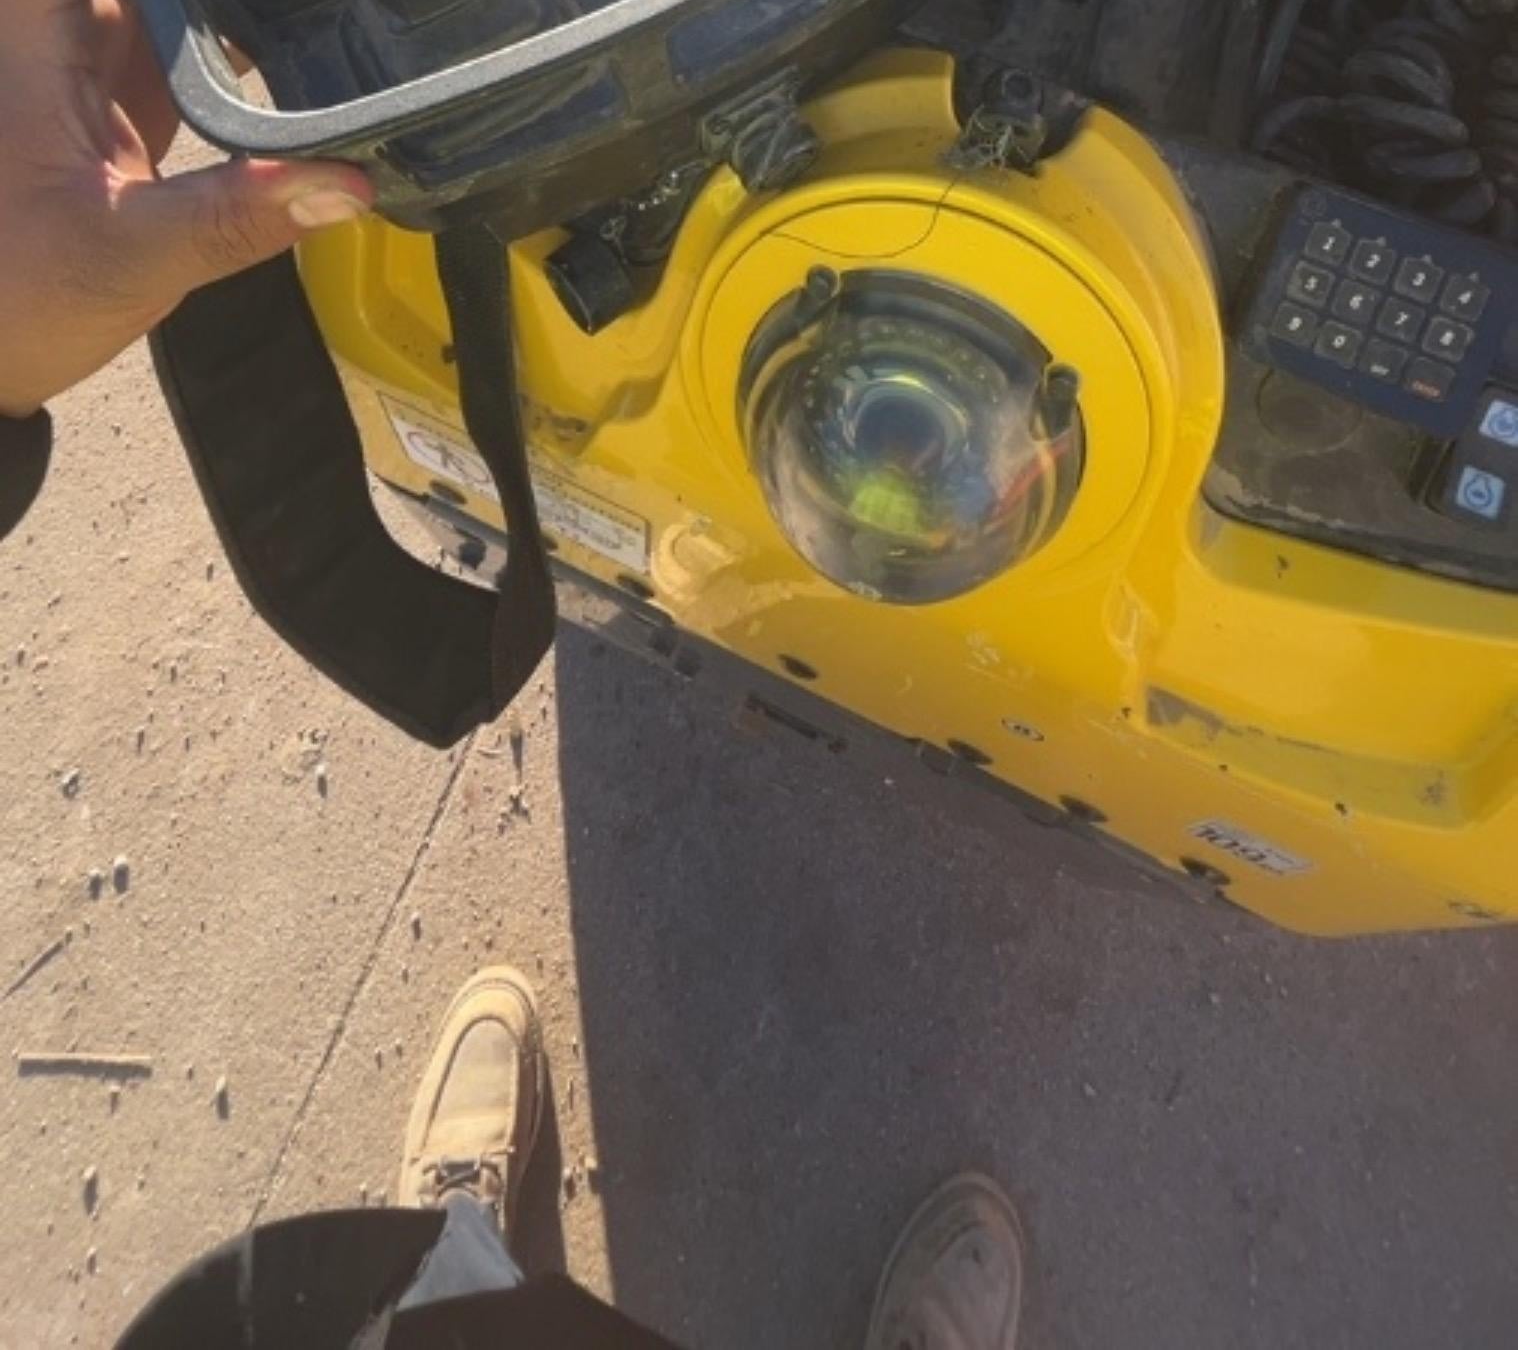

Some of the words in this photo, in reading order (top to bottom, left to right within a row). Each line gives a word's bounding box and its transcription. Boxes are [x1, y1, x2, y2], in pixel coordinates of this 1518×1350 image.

[1322, 236, 1336, 251] 1
[1366, 253, 1381, 269] 2
[1412, 272, 1427, 287] 3
[1287, 316, 1303, 332] 9
[1331, 334, 1347, 349] 0
[1395, 311, 1410, 325] 7
